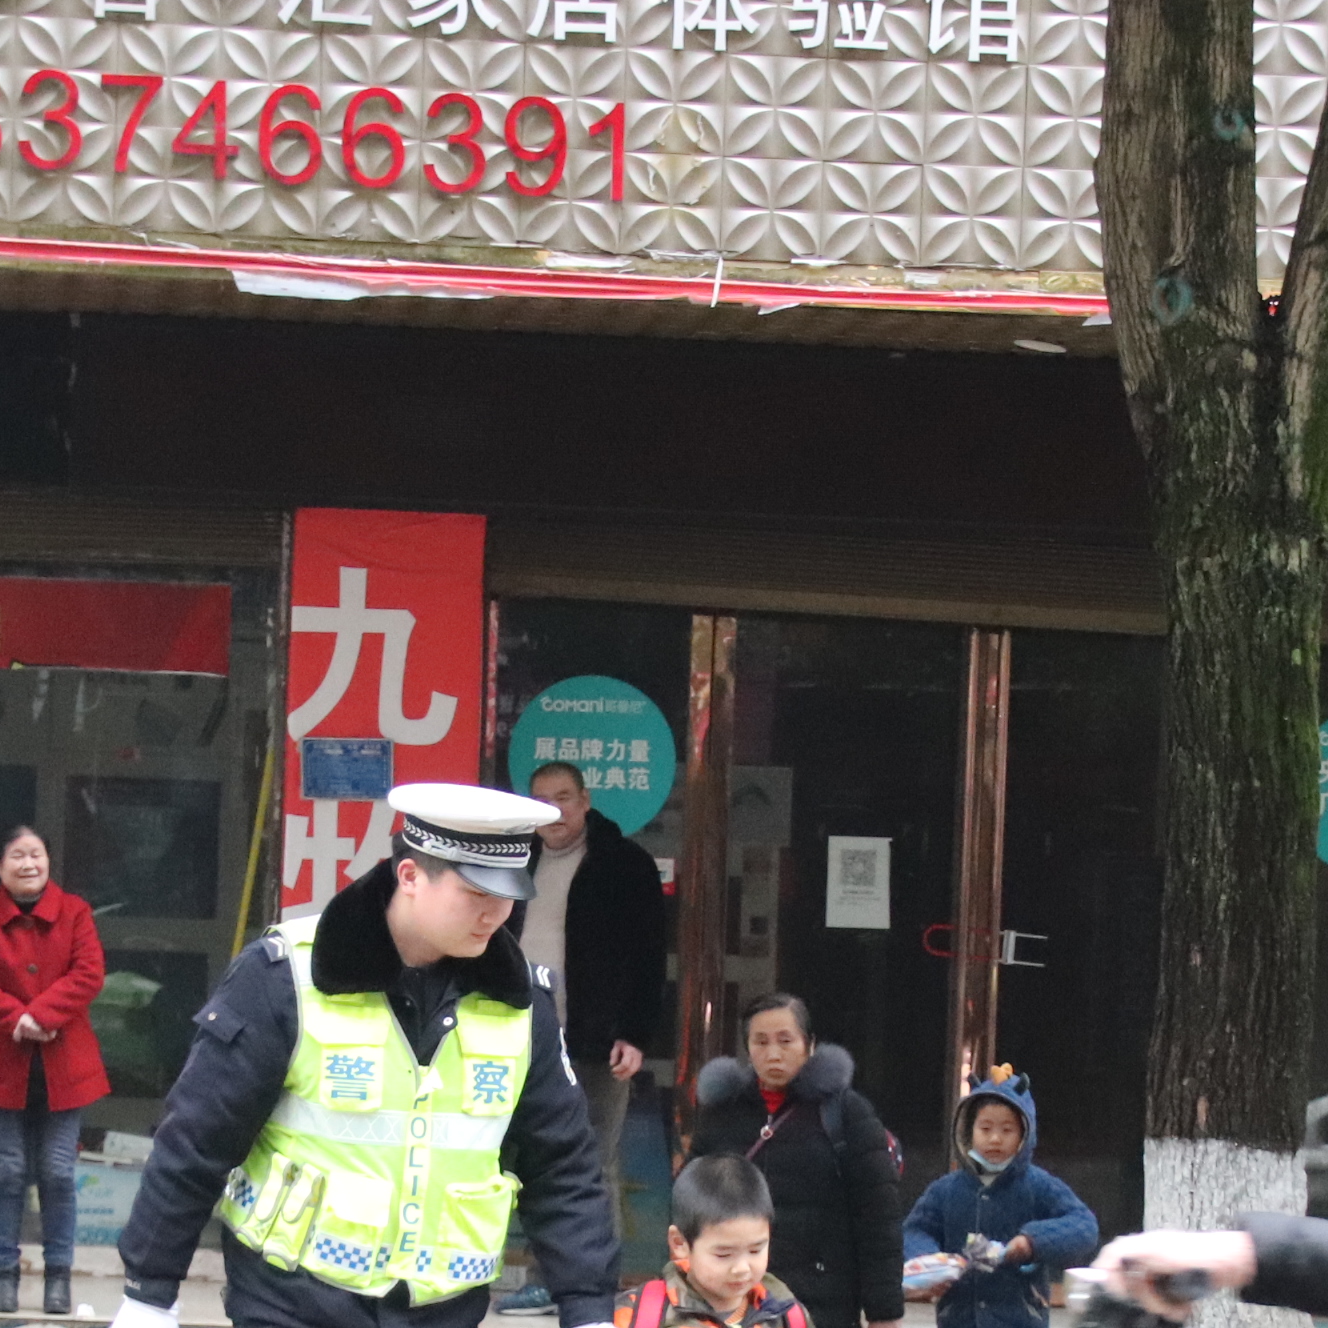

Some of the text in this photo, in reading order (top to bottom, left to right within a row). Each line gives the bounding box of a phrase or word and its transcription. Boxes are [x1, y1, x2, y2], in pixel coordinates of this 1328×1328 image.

[533, 737, 650, 763] 展品牌力量
[324, 1053, 510, 1105] 警 察
